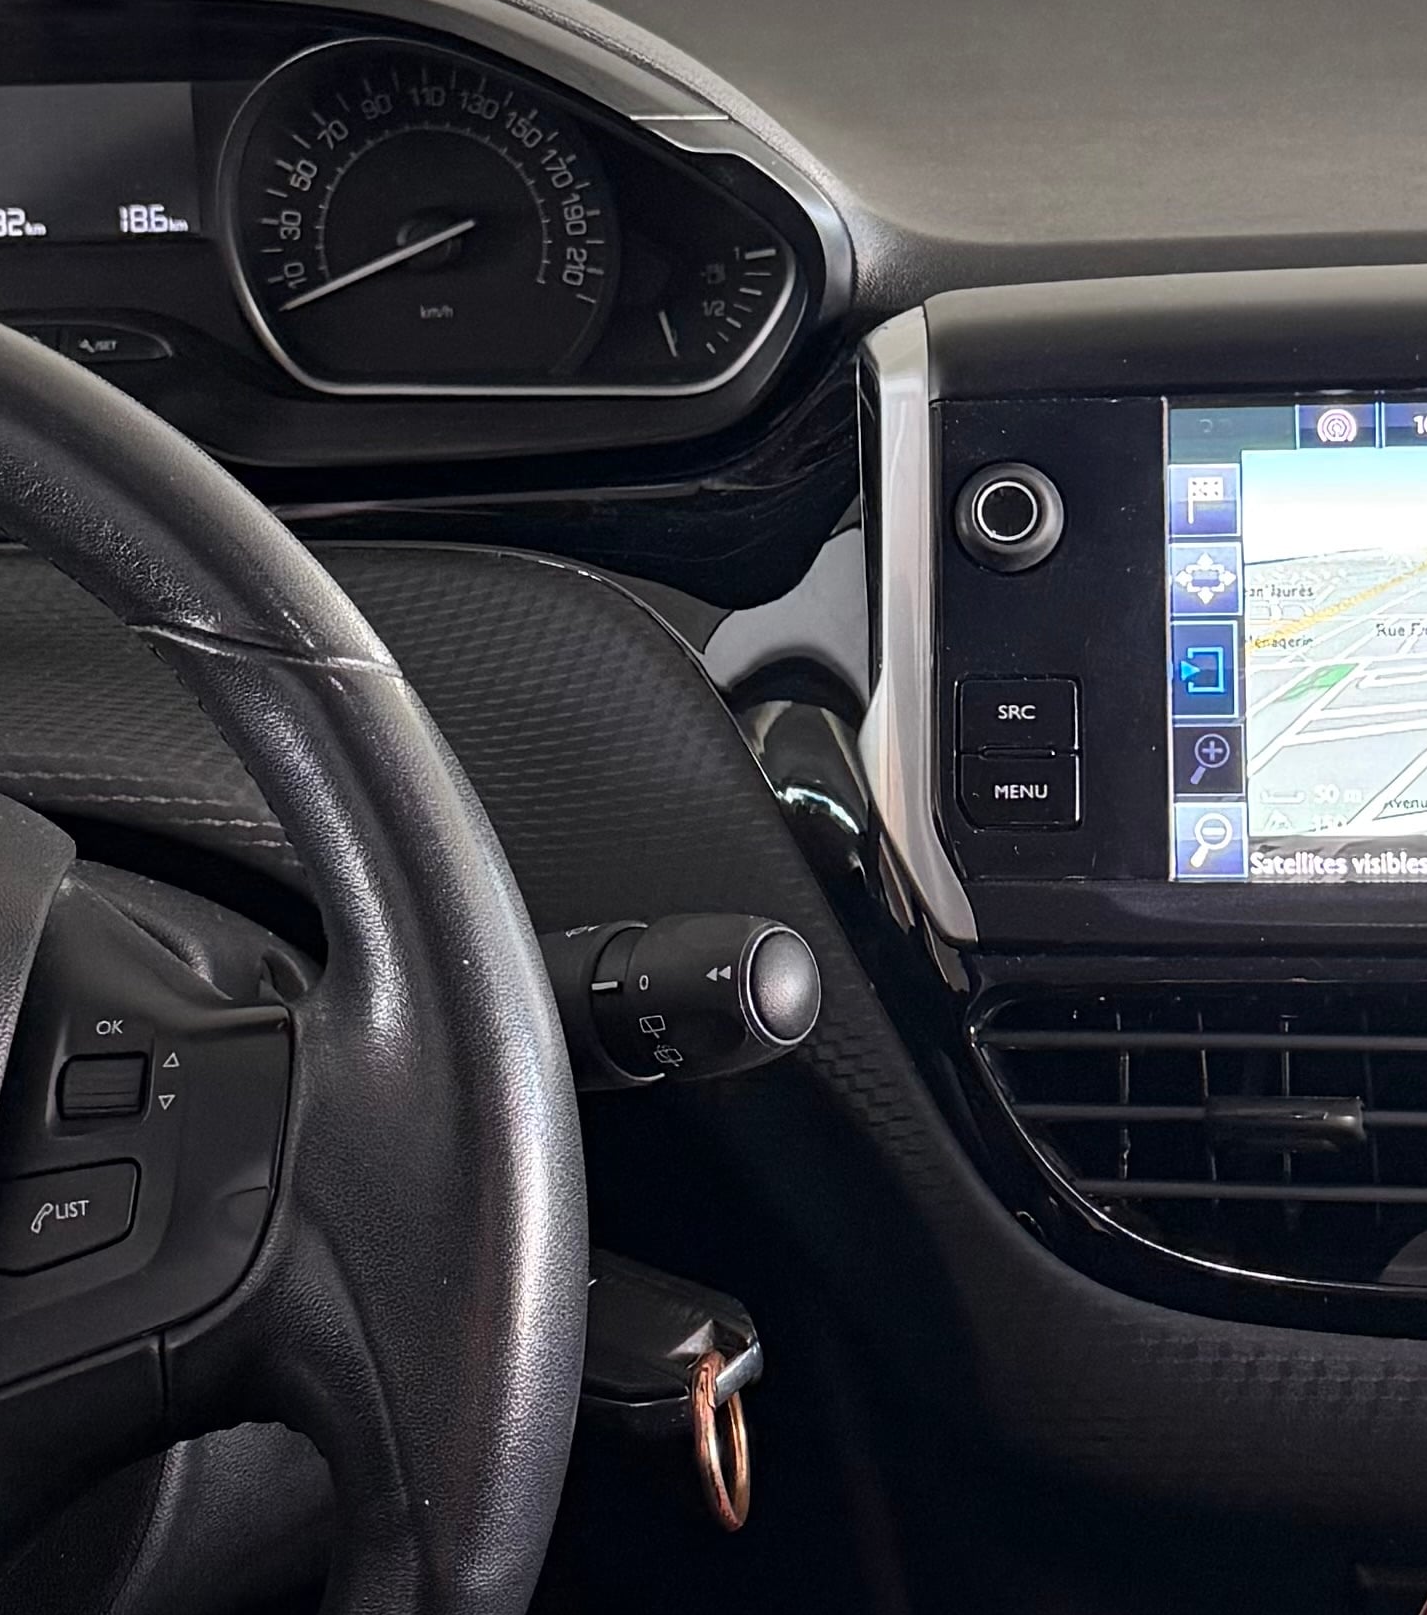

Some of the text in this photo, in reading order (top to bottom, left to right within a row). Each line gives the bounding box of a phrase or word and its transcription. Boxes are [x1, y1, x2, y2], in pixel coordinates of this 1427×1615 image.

[361, 94, 392, 121] 90
[410, 86, 445, 108] 110
[460, 90, 499, 121] 130
[317, 119, 349, 150] 70
[505, 111, 542, 150] 150
[290, 159, 318, 191] 50
[540, 148, 573, 189] 170
[280, 210, 302, 241] 30
[561, 192, 587, 236] 190
[285, 262, 307, 289] 10
[562, 247, 588, 287] 210
[420, 304, 453, 320] km/h
[998, 704, 1036, 719] SRC
[994, 784, 1048, 799] MENU
[1250, 852, 1348, 875] Satellites
[96, 1020, 124, 1035] OK
[55, 1200, 91, 1220] LIST
